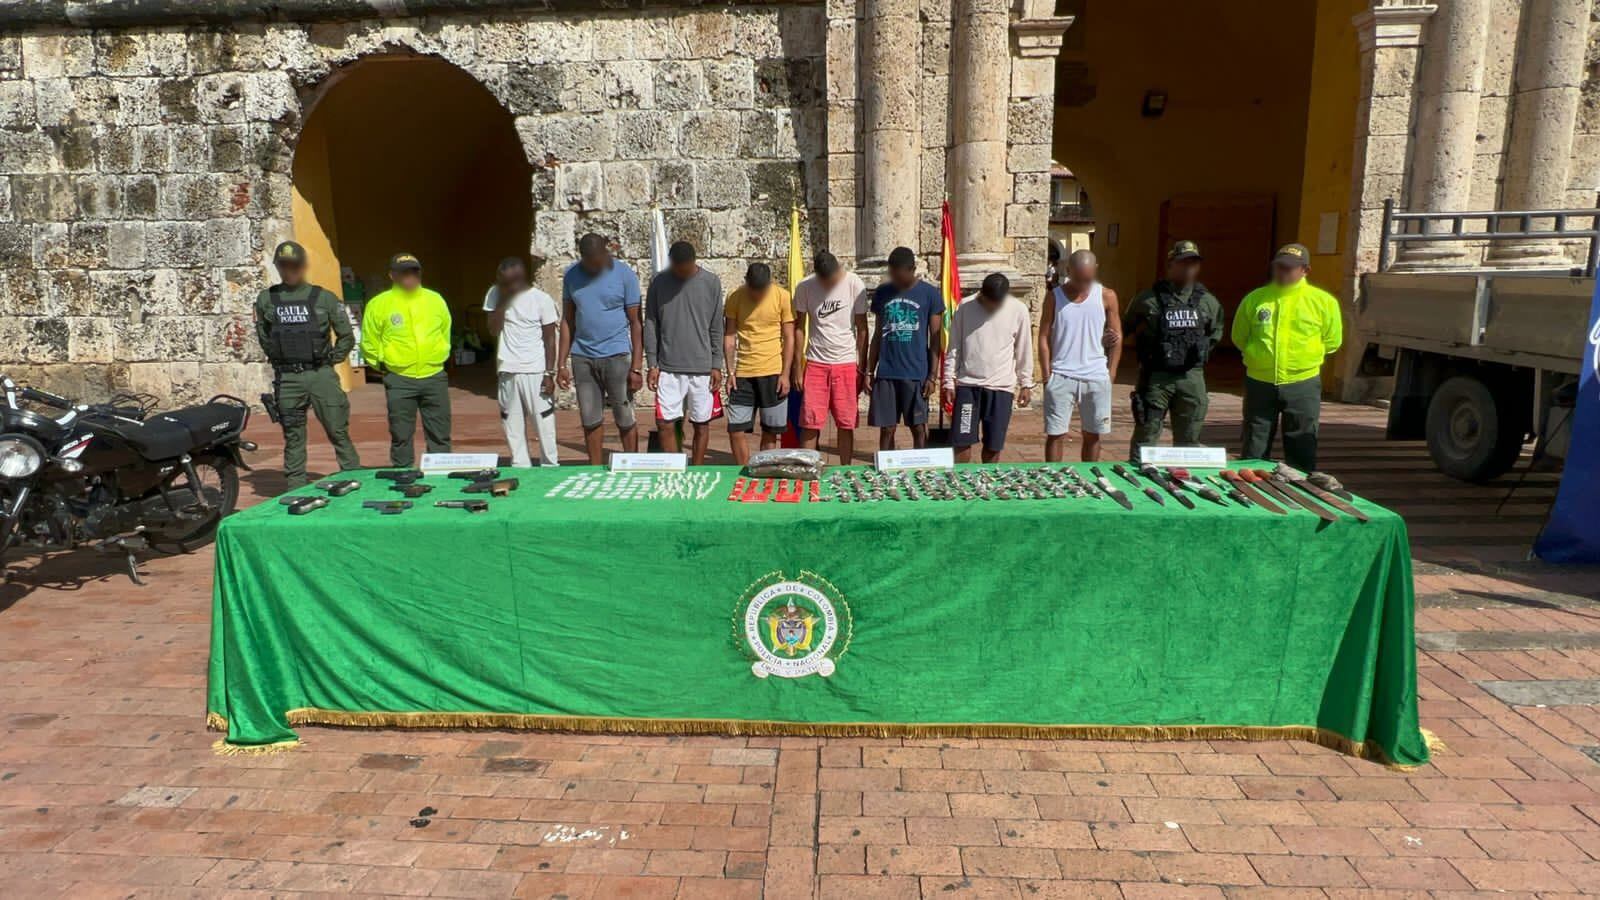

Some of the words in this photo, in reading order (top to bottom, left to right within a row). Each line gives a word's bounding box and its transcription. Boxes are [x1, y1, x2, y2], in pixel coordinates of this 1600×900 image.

[276, 306, 309, 316] GAULA
[821, 300, 842, 311] NIKE
[1165, 310, 1199, 320] GAULA
[806, 589, 834, 631] COLOMBIA
[792, 641, 832, 667] NACIONAL
